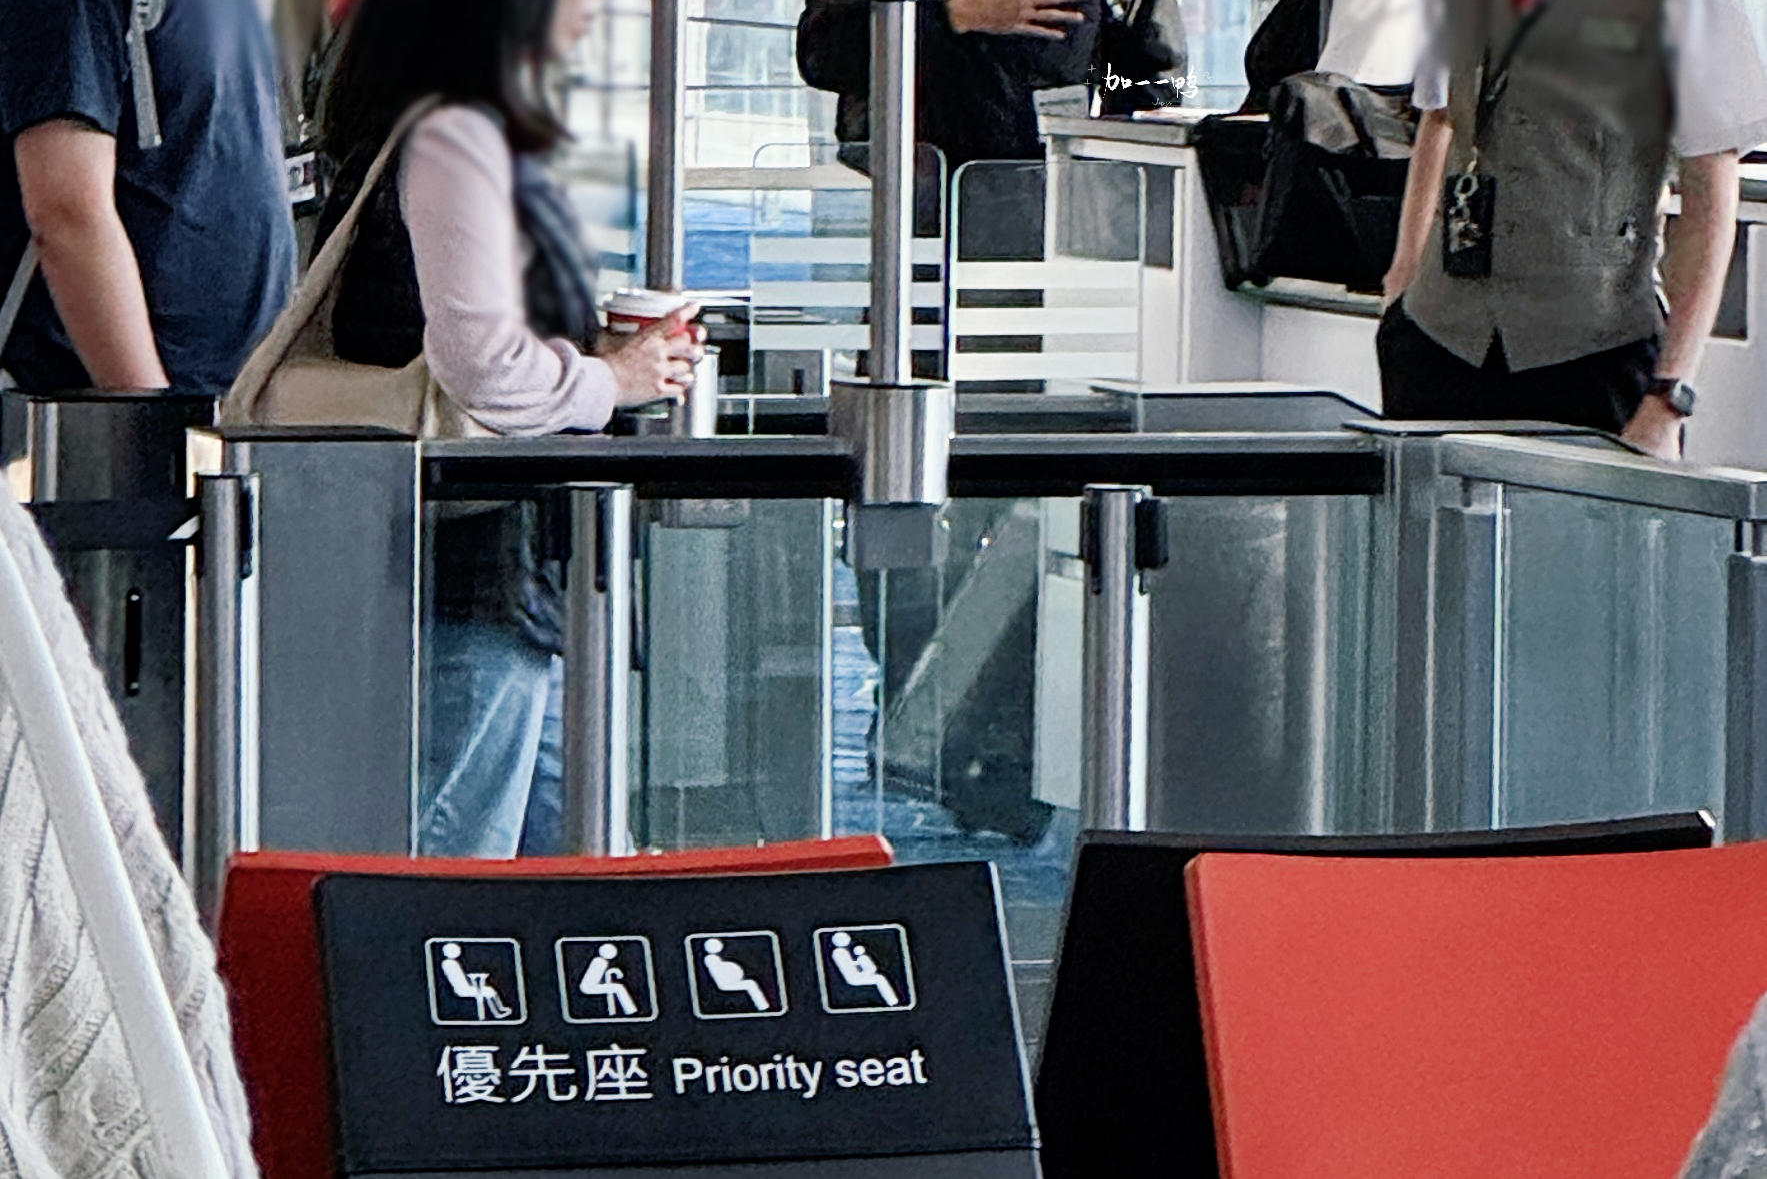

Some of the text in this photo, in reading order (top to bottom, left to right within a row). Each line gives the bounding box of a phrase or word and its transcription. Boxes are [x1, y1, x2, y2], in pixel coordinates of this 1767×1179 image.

[436, 1043, 928, 1104] 優先座 Priority seat
